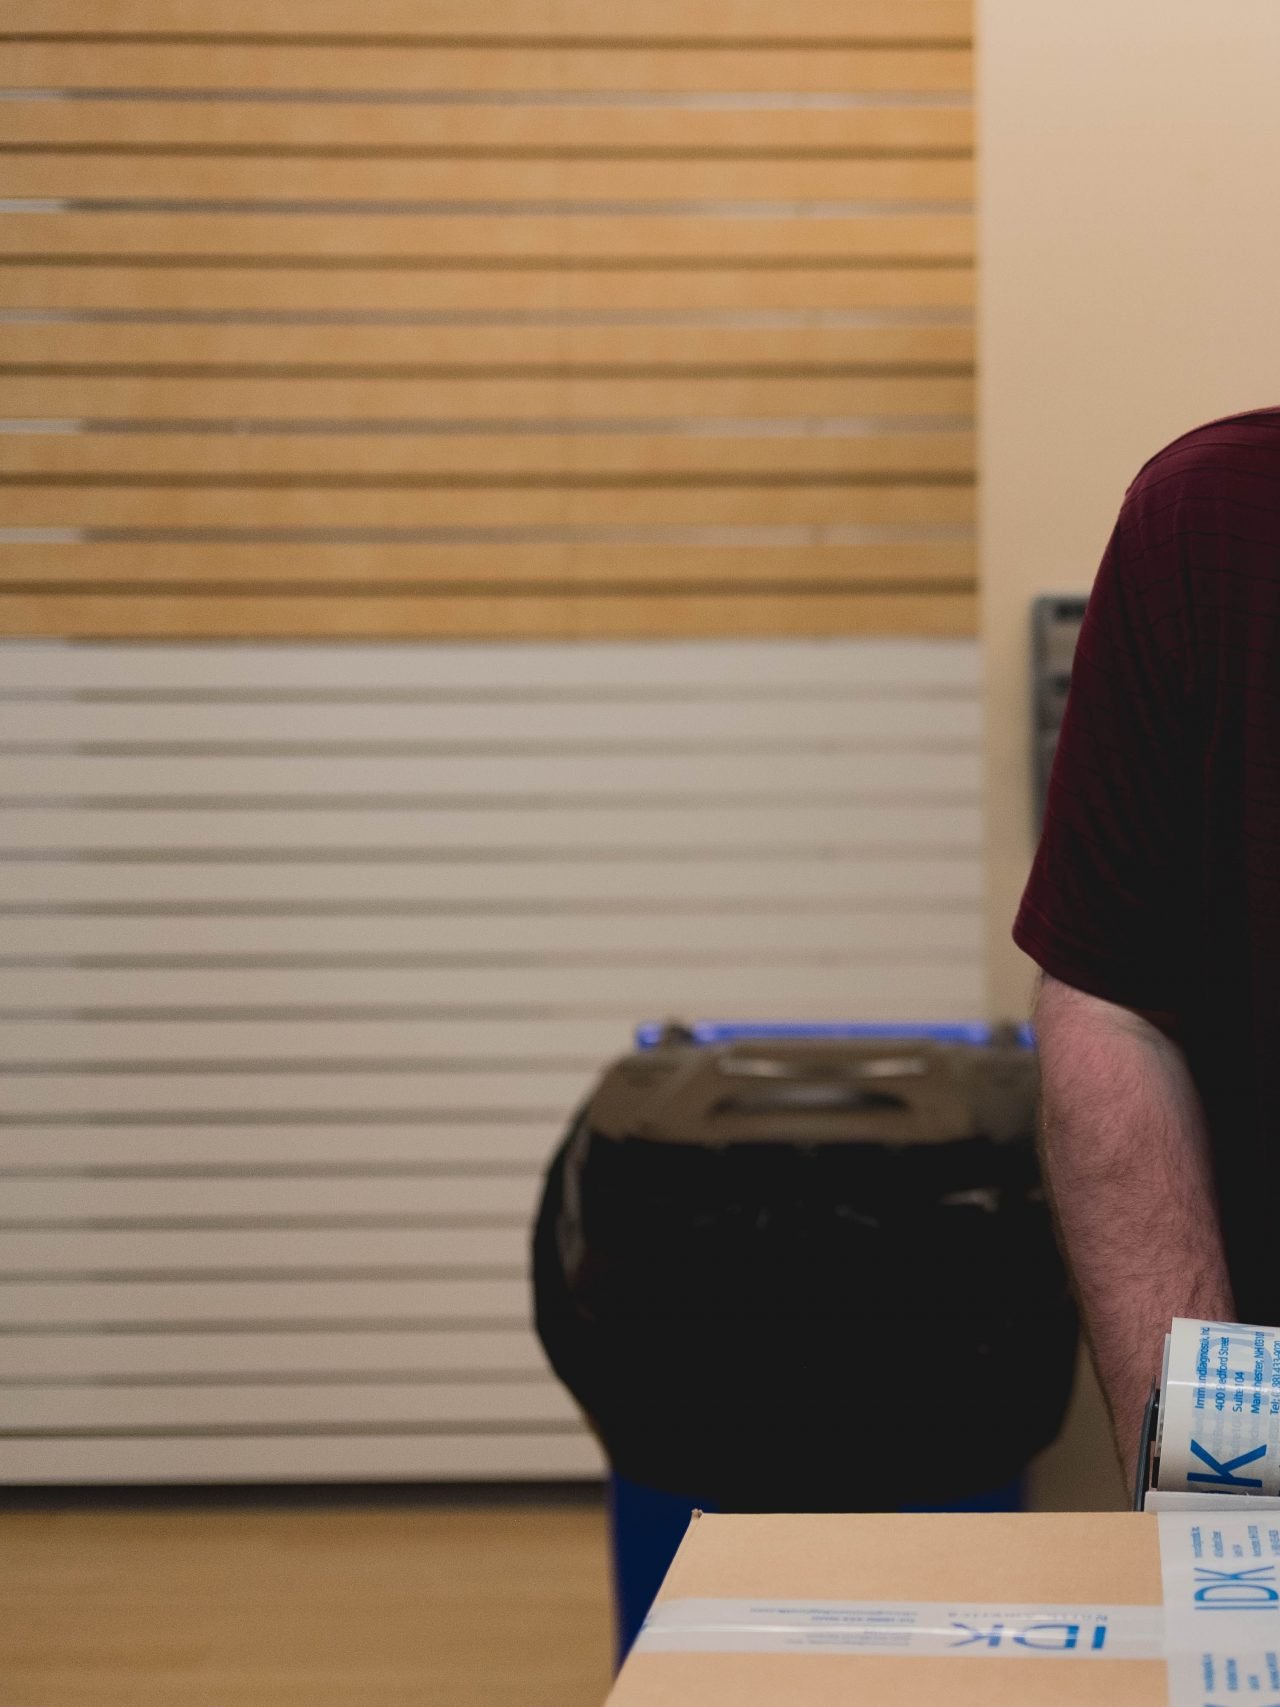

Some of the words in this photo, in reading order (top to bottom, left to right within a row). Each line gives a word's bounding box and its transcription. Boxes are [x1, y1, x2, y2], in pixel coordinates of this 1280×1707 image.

[1219, 1336, 1229, 1355] Street
[1215, 1392, 1226, 1411] 400
[1194, 1565, 1279, 1610] IDK
[949, 1621, 1107, 1649] IDK
